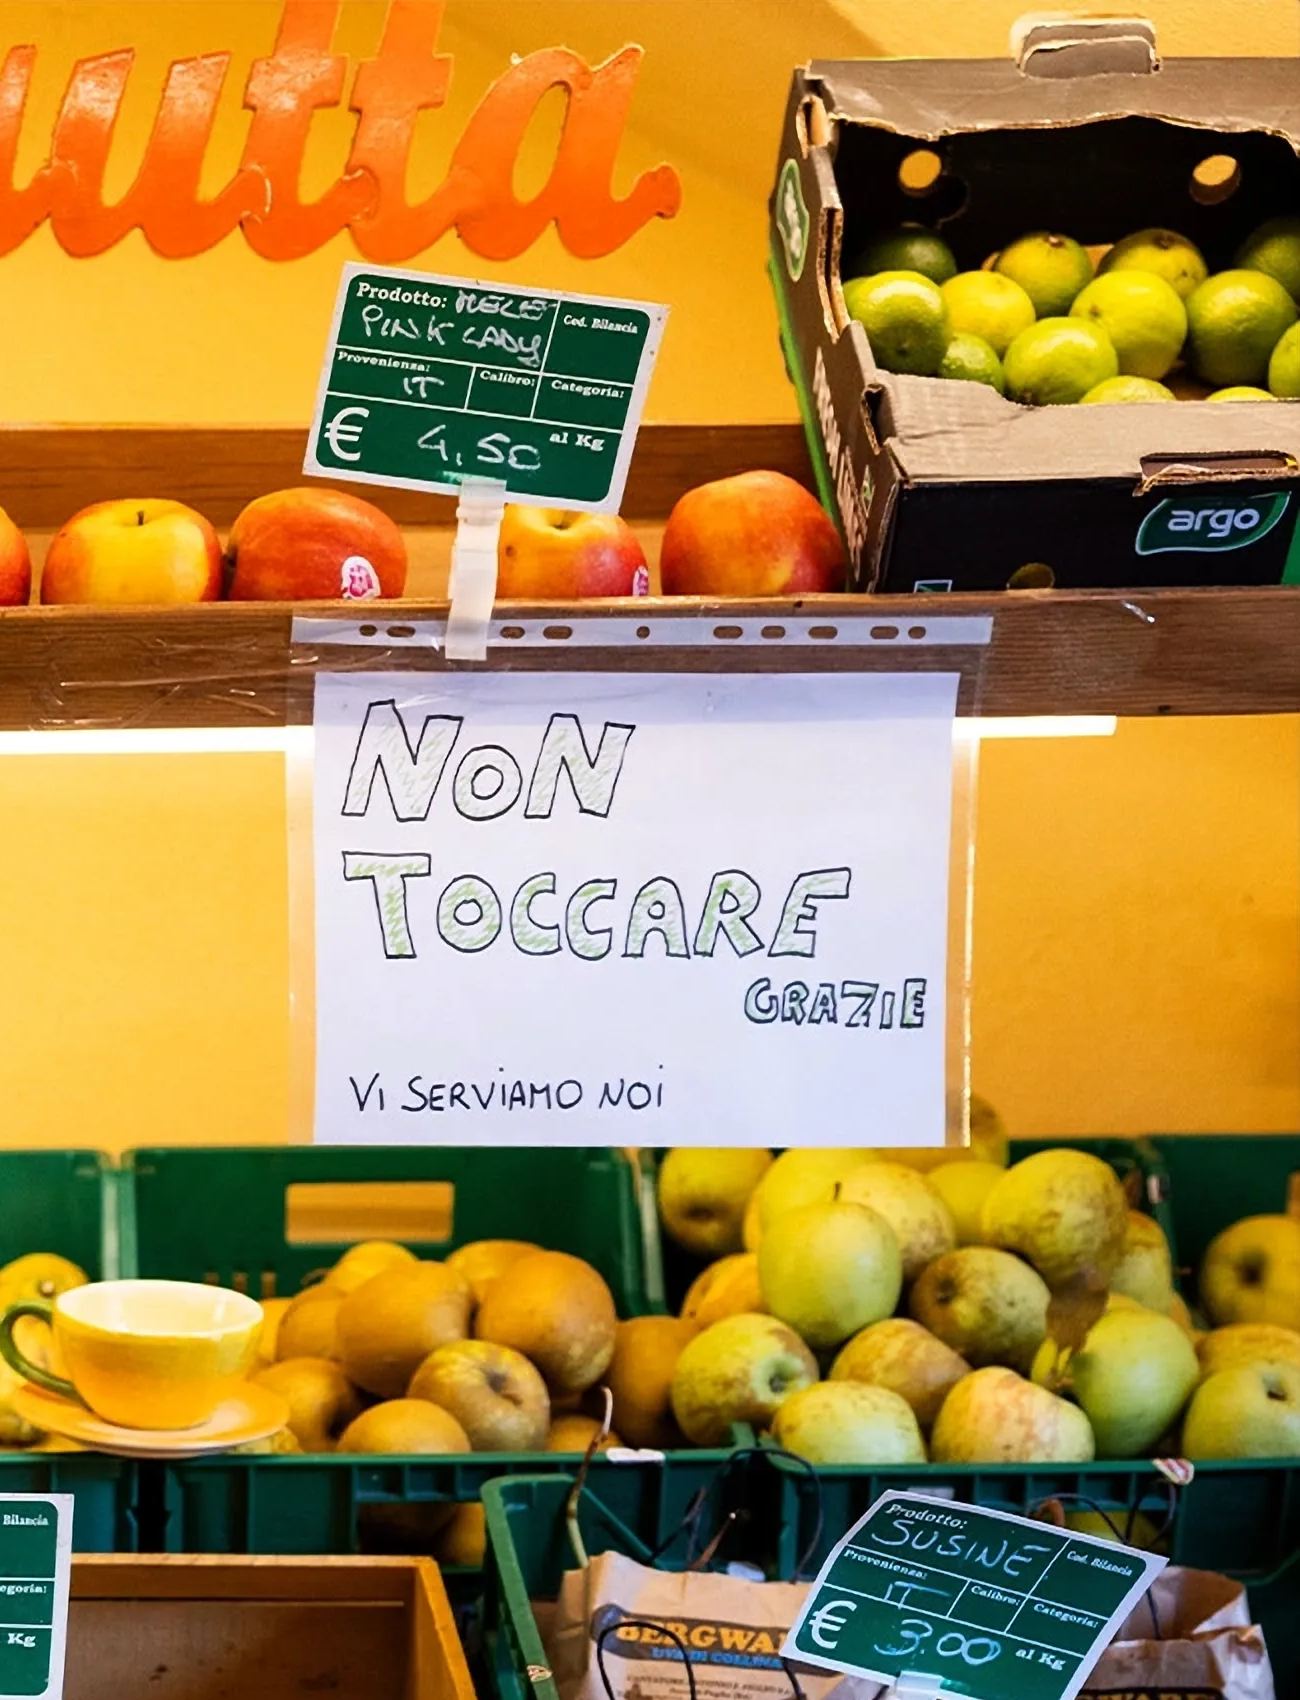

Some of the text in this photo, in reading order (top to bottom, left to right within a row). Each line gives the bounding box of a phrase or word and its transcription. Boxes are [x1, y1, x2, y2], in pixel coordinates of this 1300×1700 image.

[356, 282, 448, 309] Prodotto:
[361, 304, 543, 367] PINK LADY
[563, 314, 638, 335] Cod. Bilancia
[337, 350, 431, 373] Provenienza:
[403, 376, 445, 398] IT
[479, 369, 536, 388] Calibro:
[551, 379, 625, 400] Categoria:
[323, 406, 371, 462] €
[549, 431, 605, 451] al Kg
[1167, 508, 1260, 538] argo
[341, 851, 851, 961] TOCCARE
[744, 976, 928, 1030] GRAZIE
[2, 1514, 49, 1527] Bilancia
[886, 1502, 968, 1530] Prodotto:
[871, 1519, 1052, 1577] SUSINE
[844, 1548, 929, 1581] Provenienza:
[1066, 1549, 1134, 1578] Cod. Bilancia
[970, 1584, 1022, 1607] Calibro:
[808, 1599, 858, 1649] €
[1033, 1602, 1099, 1630] Categoria:
[8, 1633, 36, 1648] Kg
[615, 1616, 785, 1654] BERGWA
[1015, 1646, 1068, 1673] al Kg
